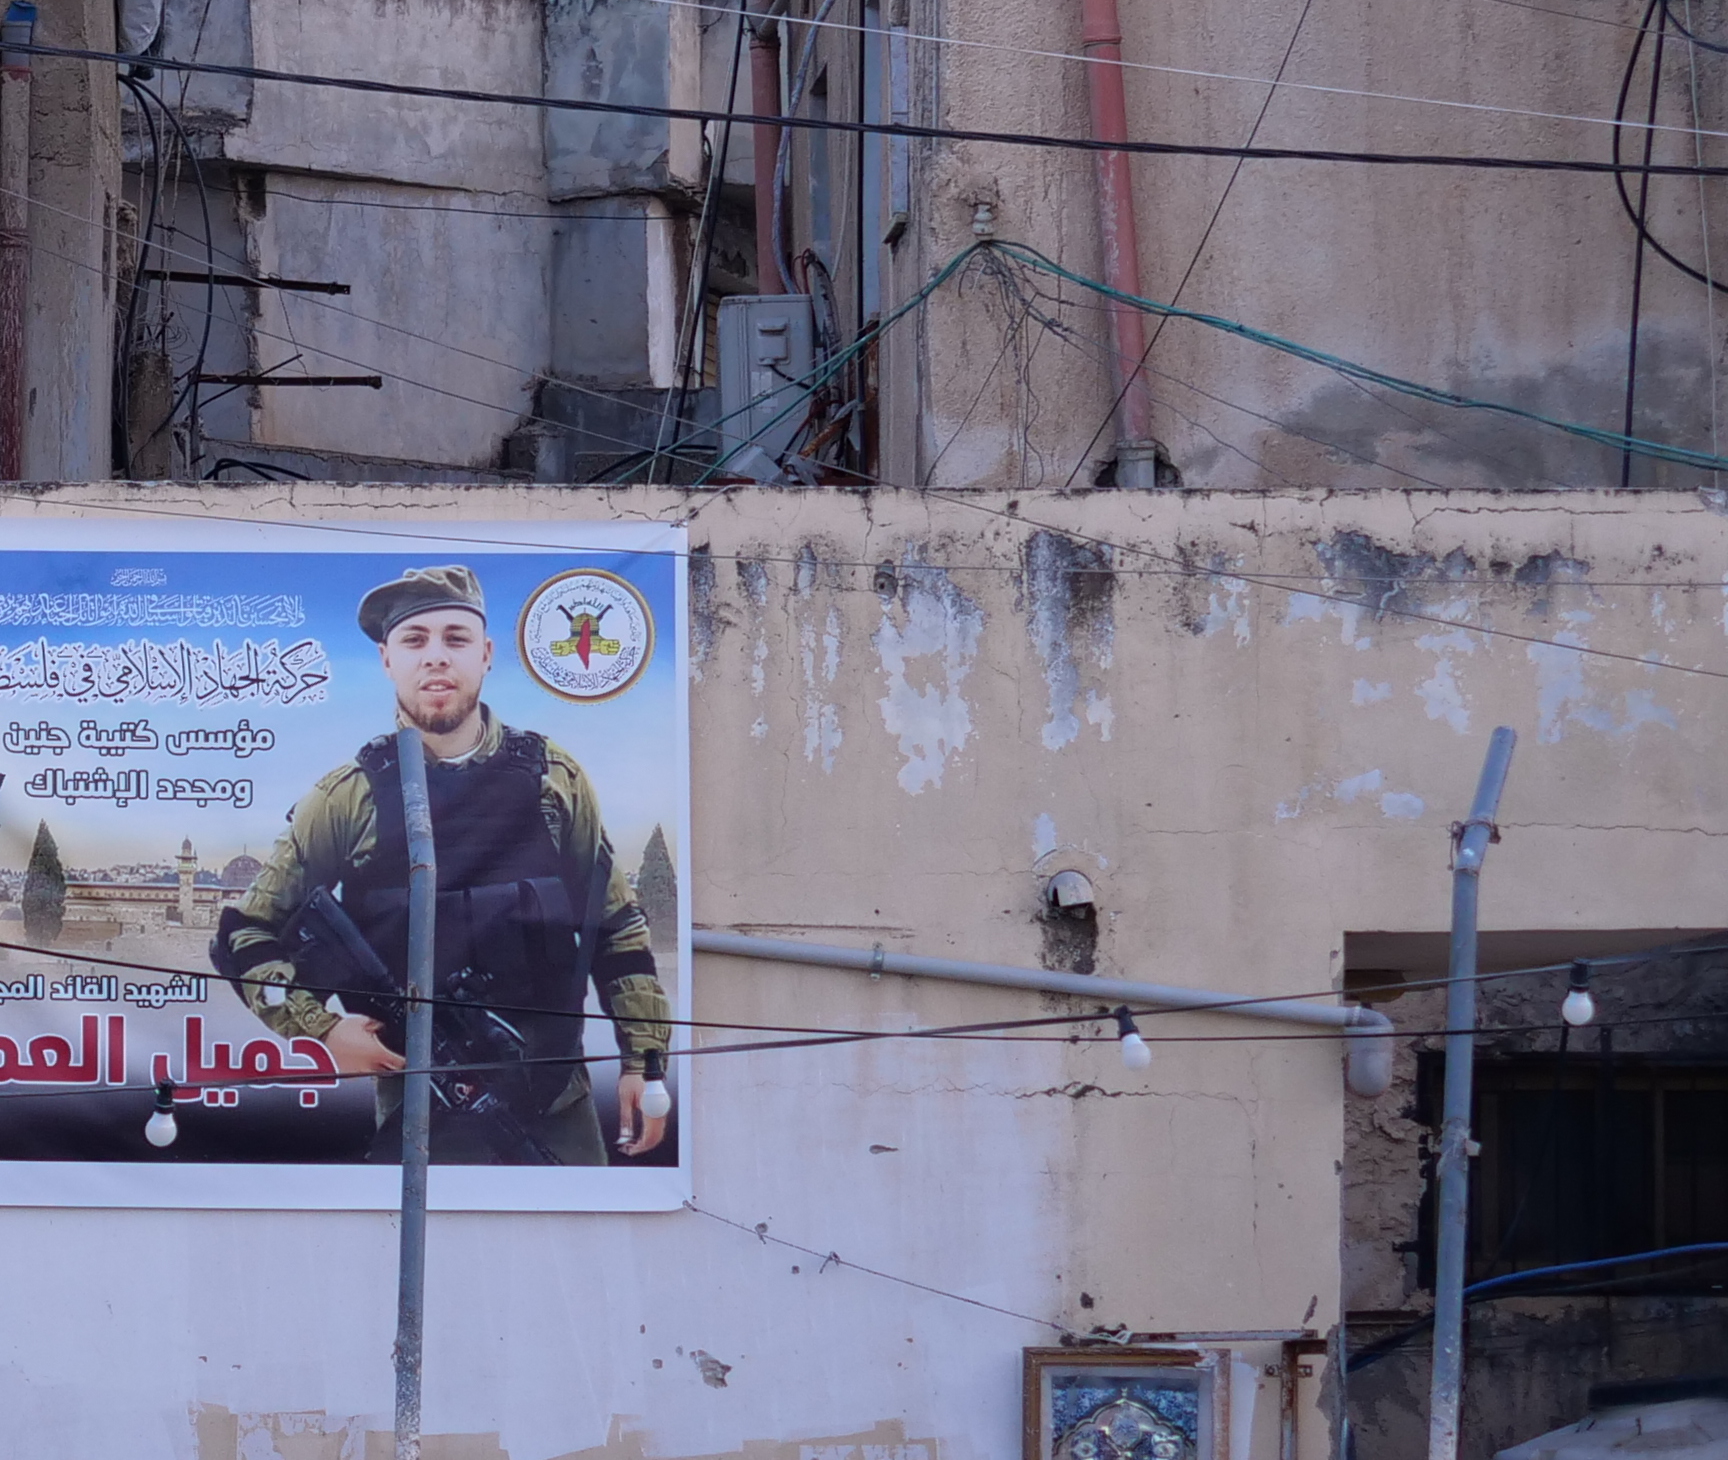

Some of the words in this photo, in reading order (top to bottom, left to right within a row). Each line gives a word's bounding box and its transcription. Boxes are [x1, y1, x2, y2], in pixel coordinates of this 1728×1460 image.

[2, 721, 71, 755] جنين
[78, 719, 158, 756] كتيبة
[165, 719, 275, 757] مؤسس
[24, 768, 148, 808] الإشتباك
[156, 777, 253, 808] ومجدد
[50, 976, 118, 1003] القائد
[123, 977, 207, 1008] الشهيد
[151, 1014, 340, 1108] جميل
